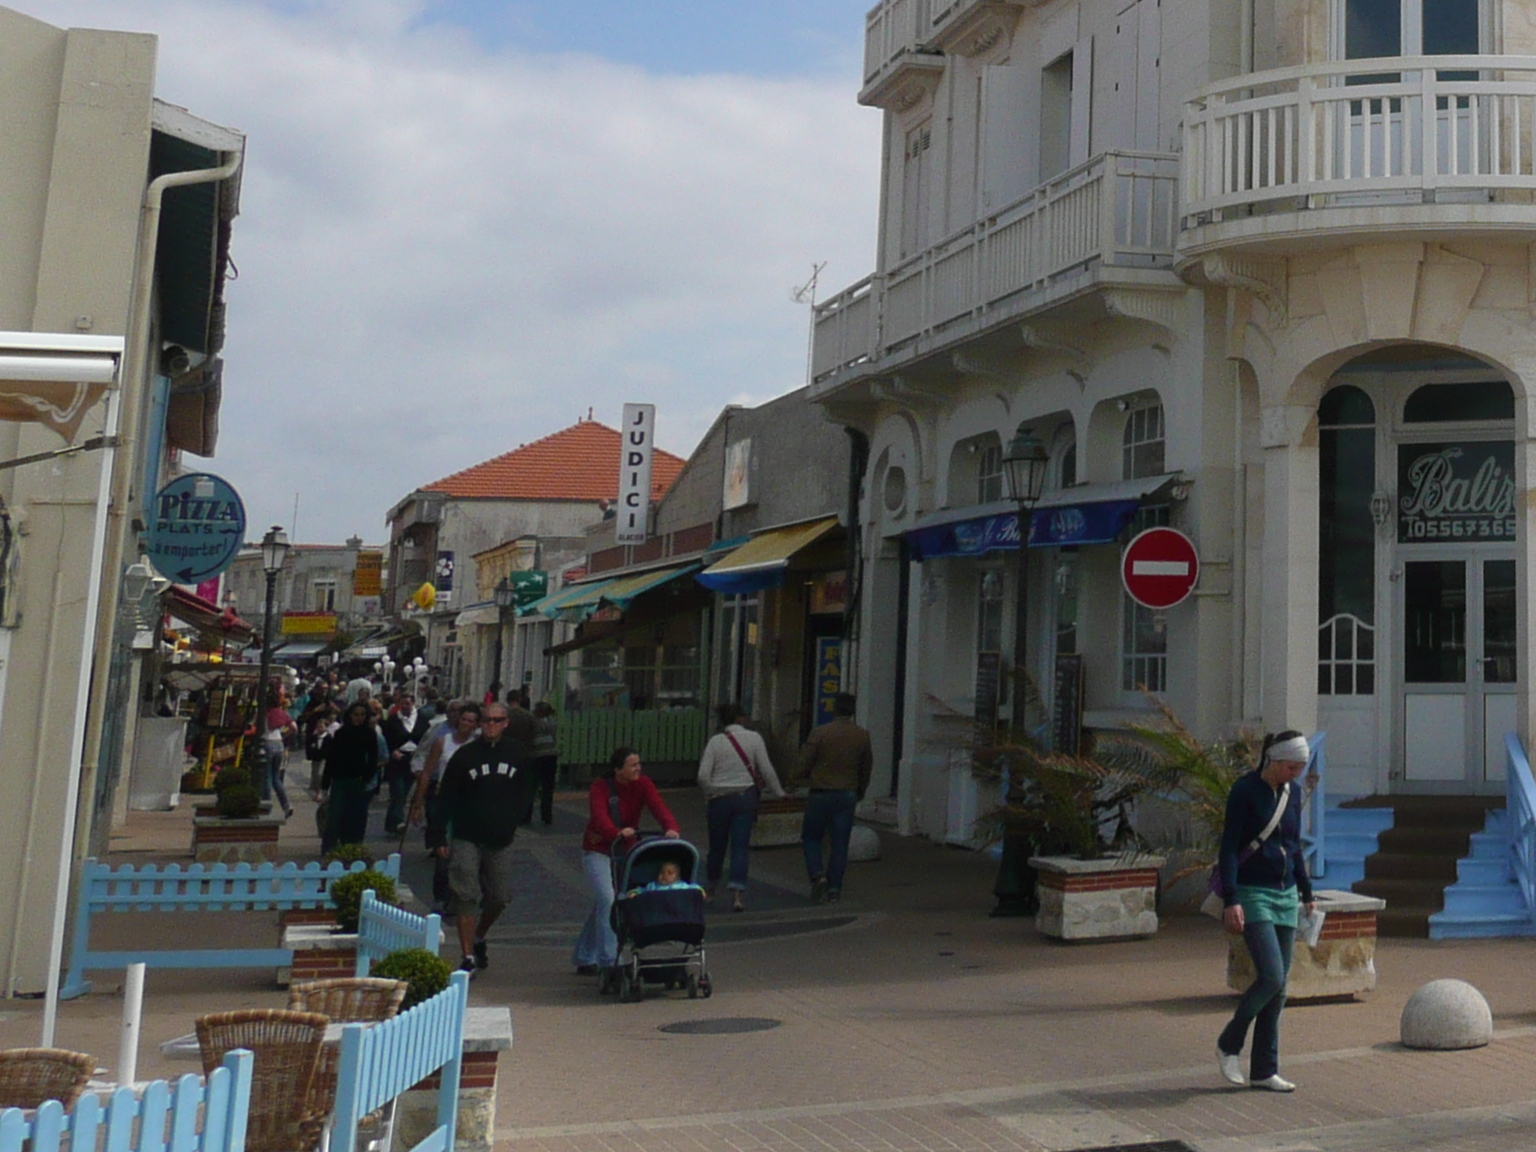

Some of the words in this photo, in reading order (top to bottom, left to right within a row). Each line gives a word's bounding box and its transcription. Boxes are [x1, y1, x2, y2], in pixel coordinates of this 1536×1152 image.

[626, 411, 645, 529] JUDICI
[157, 522, 213, 534] PLATS
[820, 645, 841, 712] FAST
